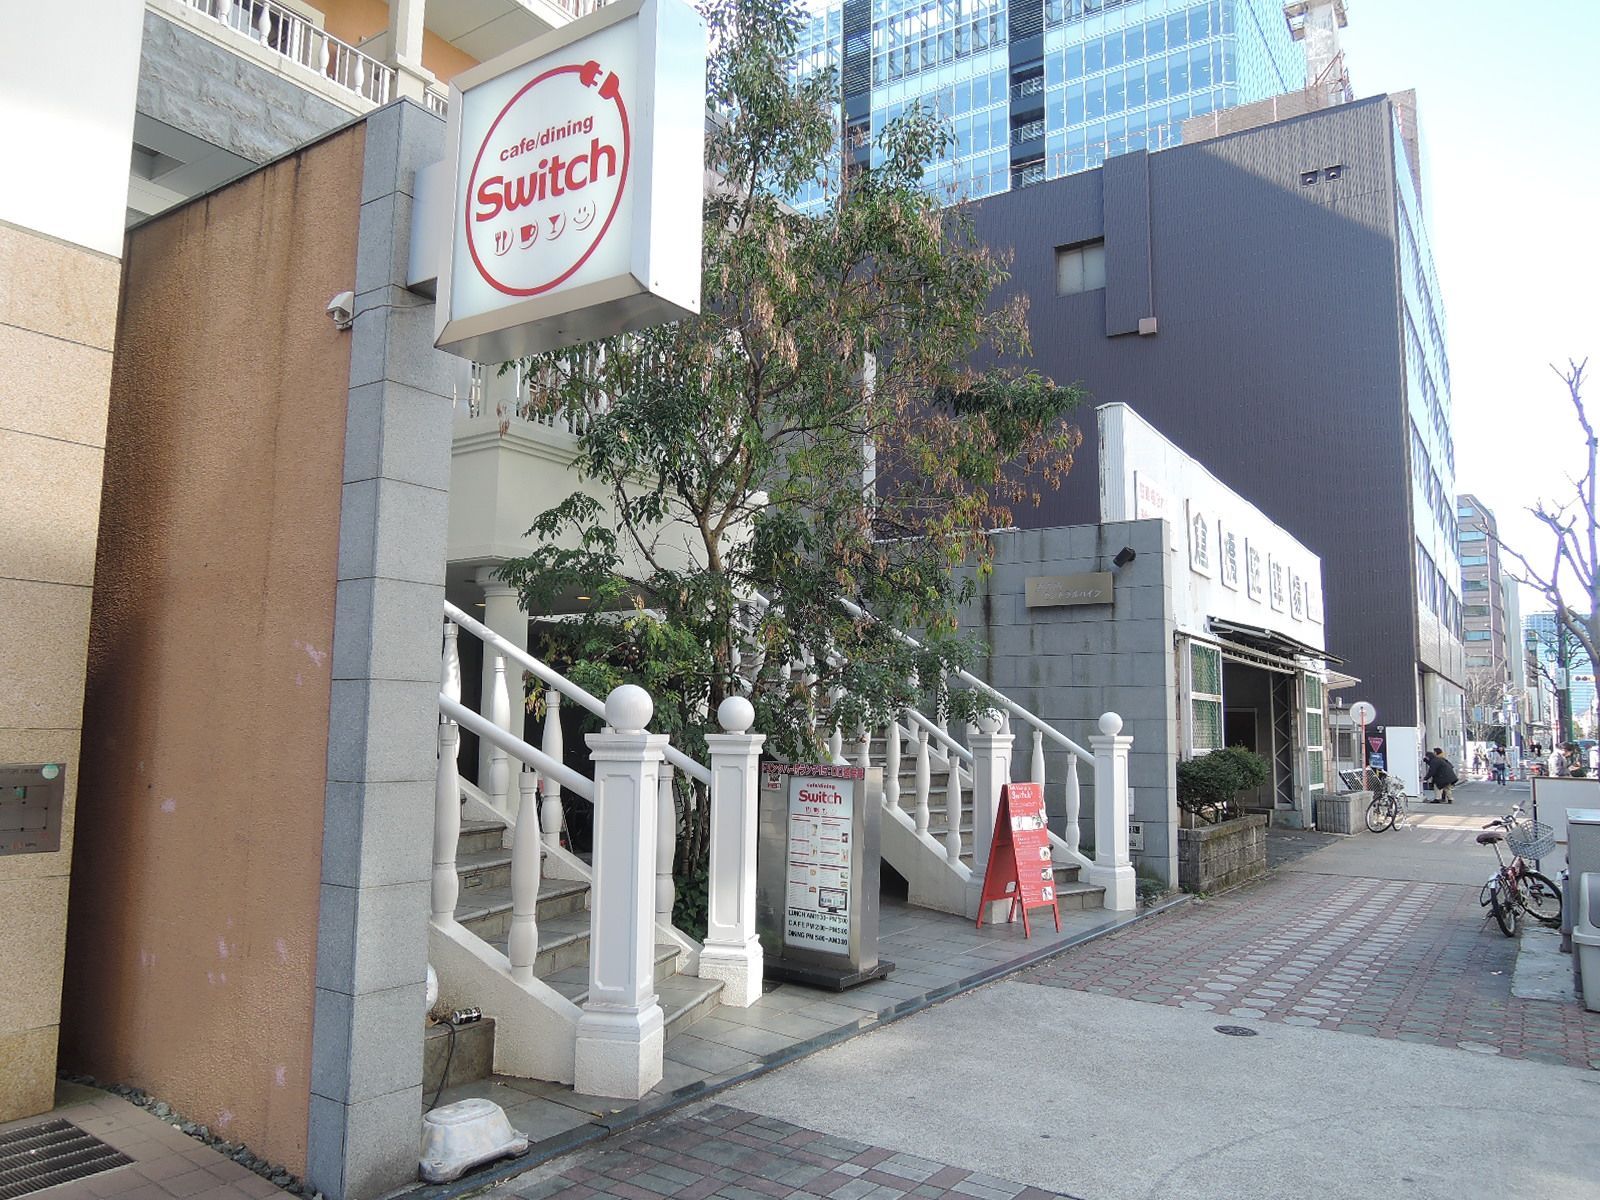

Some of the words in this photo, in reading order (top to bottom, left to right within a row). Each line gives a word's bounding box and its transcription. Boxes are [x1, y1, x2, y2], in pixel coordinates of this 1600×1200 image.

[500, 115, 593, 162] cafe/dining
[476, 137, 616, 222] Switch
[799, 789, 842, 805] Switch
[788, 909, 805, 918] LUNCH
